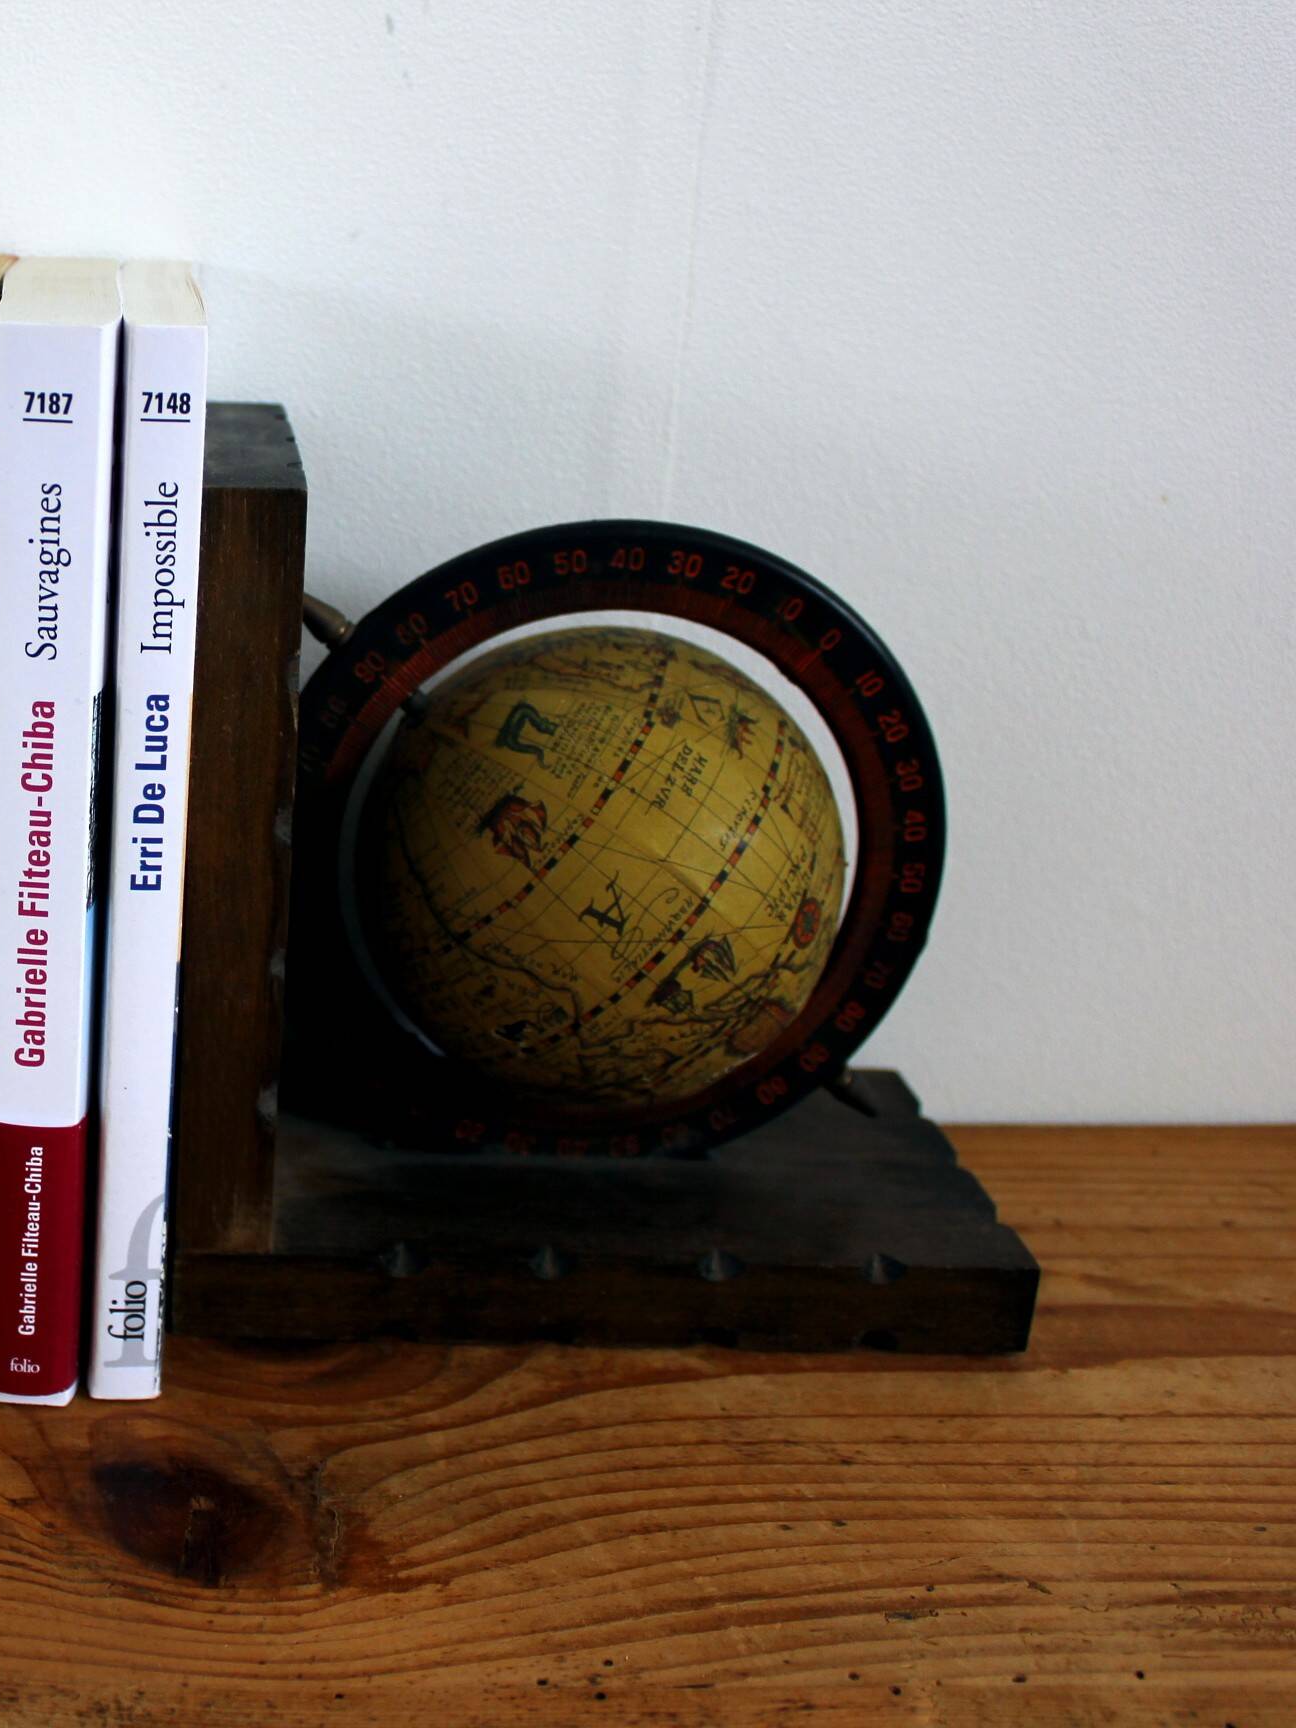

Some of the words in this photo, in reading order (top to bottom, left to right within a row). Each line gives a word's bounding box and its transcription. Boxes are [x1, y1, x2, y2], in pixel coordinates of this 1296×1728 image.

[23, 391, 74, 417] 7187
[141, 391, 192, 415] 7148
[24, 482, 72, 660] Sauvagines
[140, 480, 186, 655] Impossible
[495, 559, 534, 591] 60
[552, 546, 591, 577] 50
[609, 545, 649, 572] 40
[666, 549, 704, 578] 30
[443, 578, 482, 613] 70
[720, 562, 760, 595] 20
[775, 596, 805, 624] 10
[818, 626, 843, 652] 0
[853, 668, 886, 699] 10
[135, 693, 171, 772] Luca
[876, 706, 911, 745] 20
[894, 757, 926, 794] 30
[17, 699, 57, 918] Filteau-Chiba
[134, 782, 168, 826] De
[903, 807, 930, 844] 40
[130, 831, 164, 892] Erri
[14, 928, 50, 1068] Gabrielle
[21, 1145, 45, 1257] Filteau-Chiba
[17, 1258, 39, 1337] Gabrielle
[107, 1278, 149, 1343] folio
[9, 1356, 41, 1375] folio
